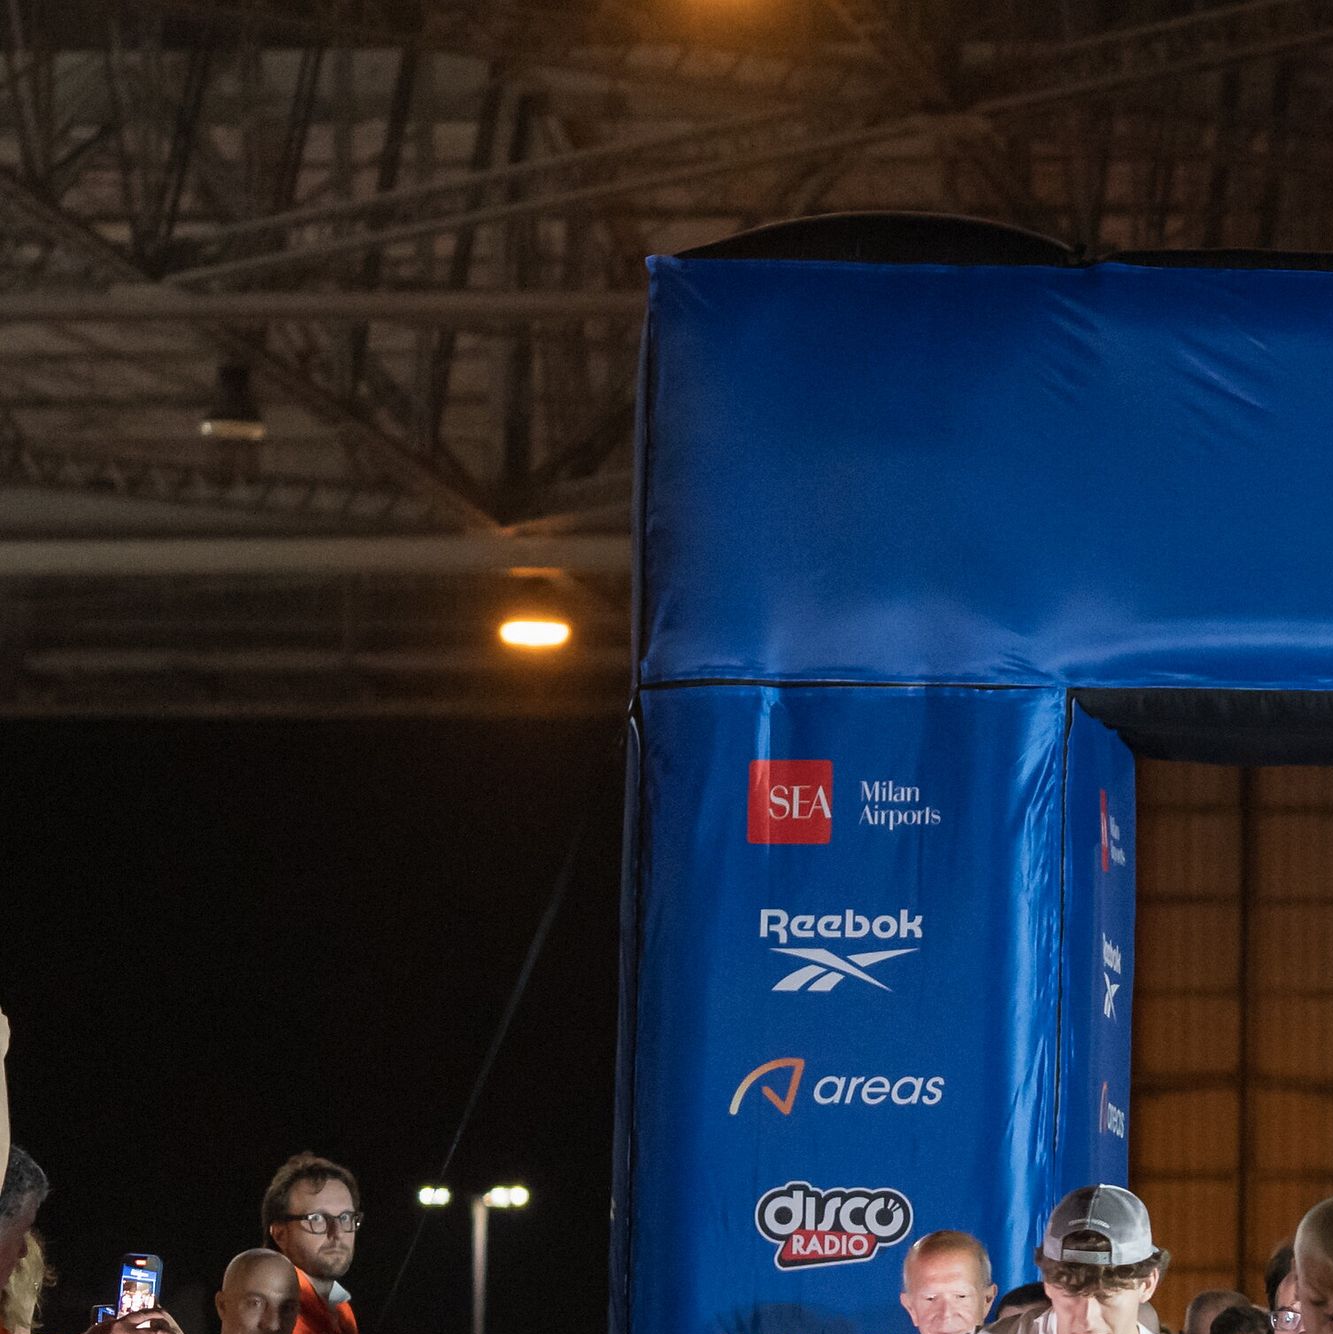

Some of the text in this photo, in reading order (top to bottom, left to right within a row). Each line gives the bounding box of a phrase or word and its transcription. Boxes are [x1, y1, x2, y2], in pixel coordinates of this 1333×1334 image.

[768, 785, 832, 820] SEA
[860, 780, 920, 802] Milan
[859, 803, 941, 831] Airports
[759, 909, 924, 943] Reebok
[813, 1075, 945, 1106] areas
[764, 1190, 906, 1237] disco
[791, 1234, 871, 1256] RADIO
